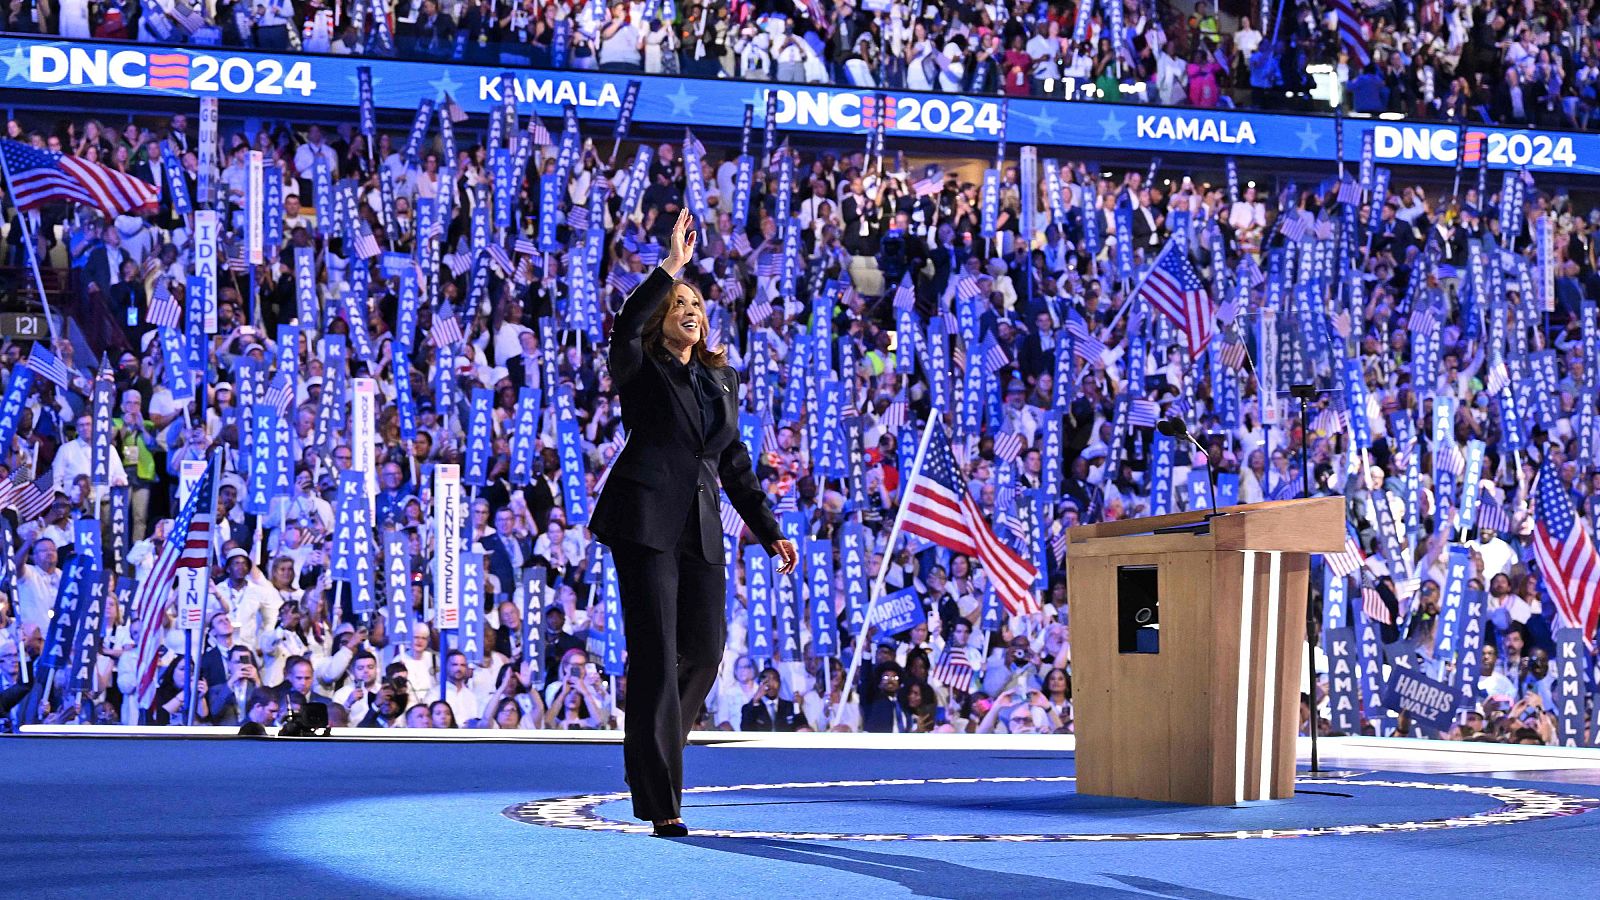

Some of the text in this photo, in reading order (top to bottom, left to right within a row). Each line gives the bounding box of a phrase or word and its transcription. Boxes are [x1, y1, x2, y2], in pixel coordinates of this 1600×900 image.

[30, 45, 317, 96] DNC 2024
[764, 89, 1001, 135] DNC 2024
[1136, 115, 1256, 144] KAMALA
[1374, 125, 1458, 162] DNC
[1486, 134, 1577, 167] 2024
[1284, 241, 1295, 288] AMALA
[16, 317, 38, 334] 121
[165, 327, 187, 388] AMALA
[816, 306, 828, 371] KAMALA
[900, 312, 911, 366] AMALA
[1415, 334, 1426, 386] AMALA
[440, 346, 453, 405] AMALA
[932, 334, 945, 405] KAMALA
[966, 354, 982, 425] KAMALA
[986, 373, 1000, 426] AMALA
[1057, 338, 1070, 406] KAMALA
[1131, 337, 1142, 391] AMALA
[1225, 367, 1237, 421] AMALA
[95, 391, 109, 475] KAMALA
[255, 416, 270, 504] KAMALA
[276, 419, 290, 487] AMALA
[469, 398, 489, 477] KAMALA
[514, 397, 536, 474] KAMALA
[820, 391, 839, 467] KAMALA
[849, 426, 864, 502] KAMALA
[1047, 420, 1059, 494] KAMALA
[561, 431, 584, 514] KAMALA
[1155, 441, 1170, 514] KAMALA
[1408, 453, 1419, 526] KAMALA
[1463, 449, 1481, 519] KAMALA
[113, 494, 124, 574] KAMALA
[335, 481, 357, 569] KALA
[353, 510, 371, 600] KAMALA
[444, 483, 455, 604] TENNESSEE
[1376, 499, 1405, 572] KAMALA
[49, 565, 84, 658] KAMALA
[391, 543, 408, 634] KAMALA
[464, 563, 478, 652] KAMALA
[606, 567, 618, 663] KAMALA
[751, 557, 768, 647] KAMALA
[781, 575, 798, 650] AMALA
[813, 552, 832, 644] KAMALA
[845, 535, 864, 624] KAMALA
[871, 594, 916, 625] HARRIS
[1438, 565, 1464, 651] KAMALA
[77, 583, 103, 680] KAMALA
[529, 580, 541, 672] KAMALA
[1460, 602, 1481, 698] KAMALA
[1333, 641, 1352, 728] KAMAL
[1363, 626, 1381, 707] AMALA
[1395, 673, 1454, 712] HARRIS
[1399, 696, 1440, 721] WALZ
